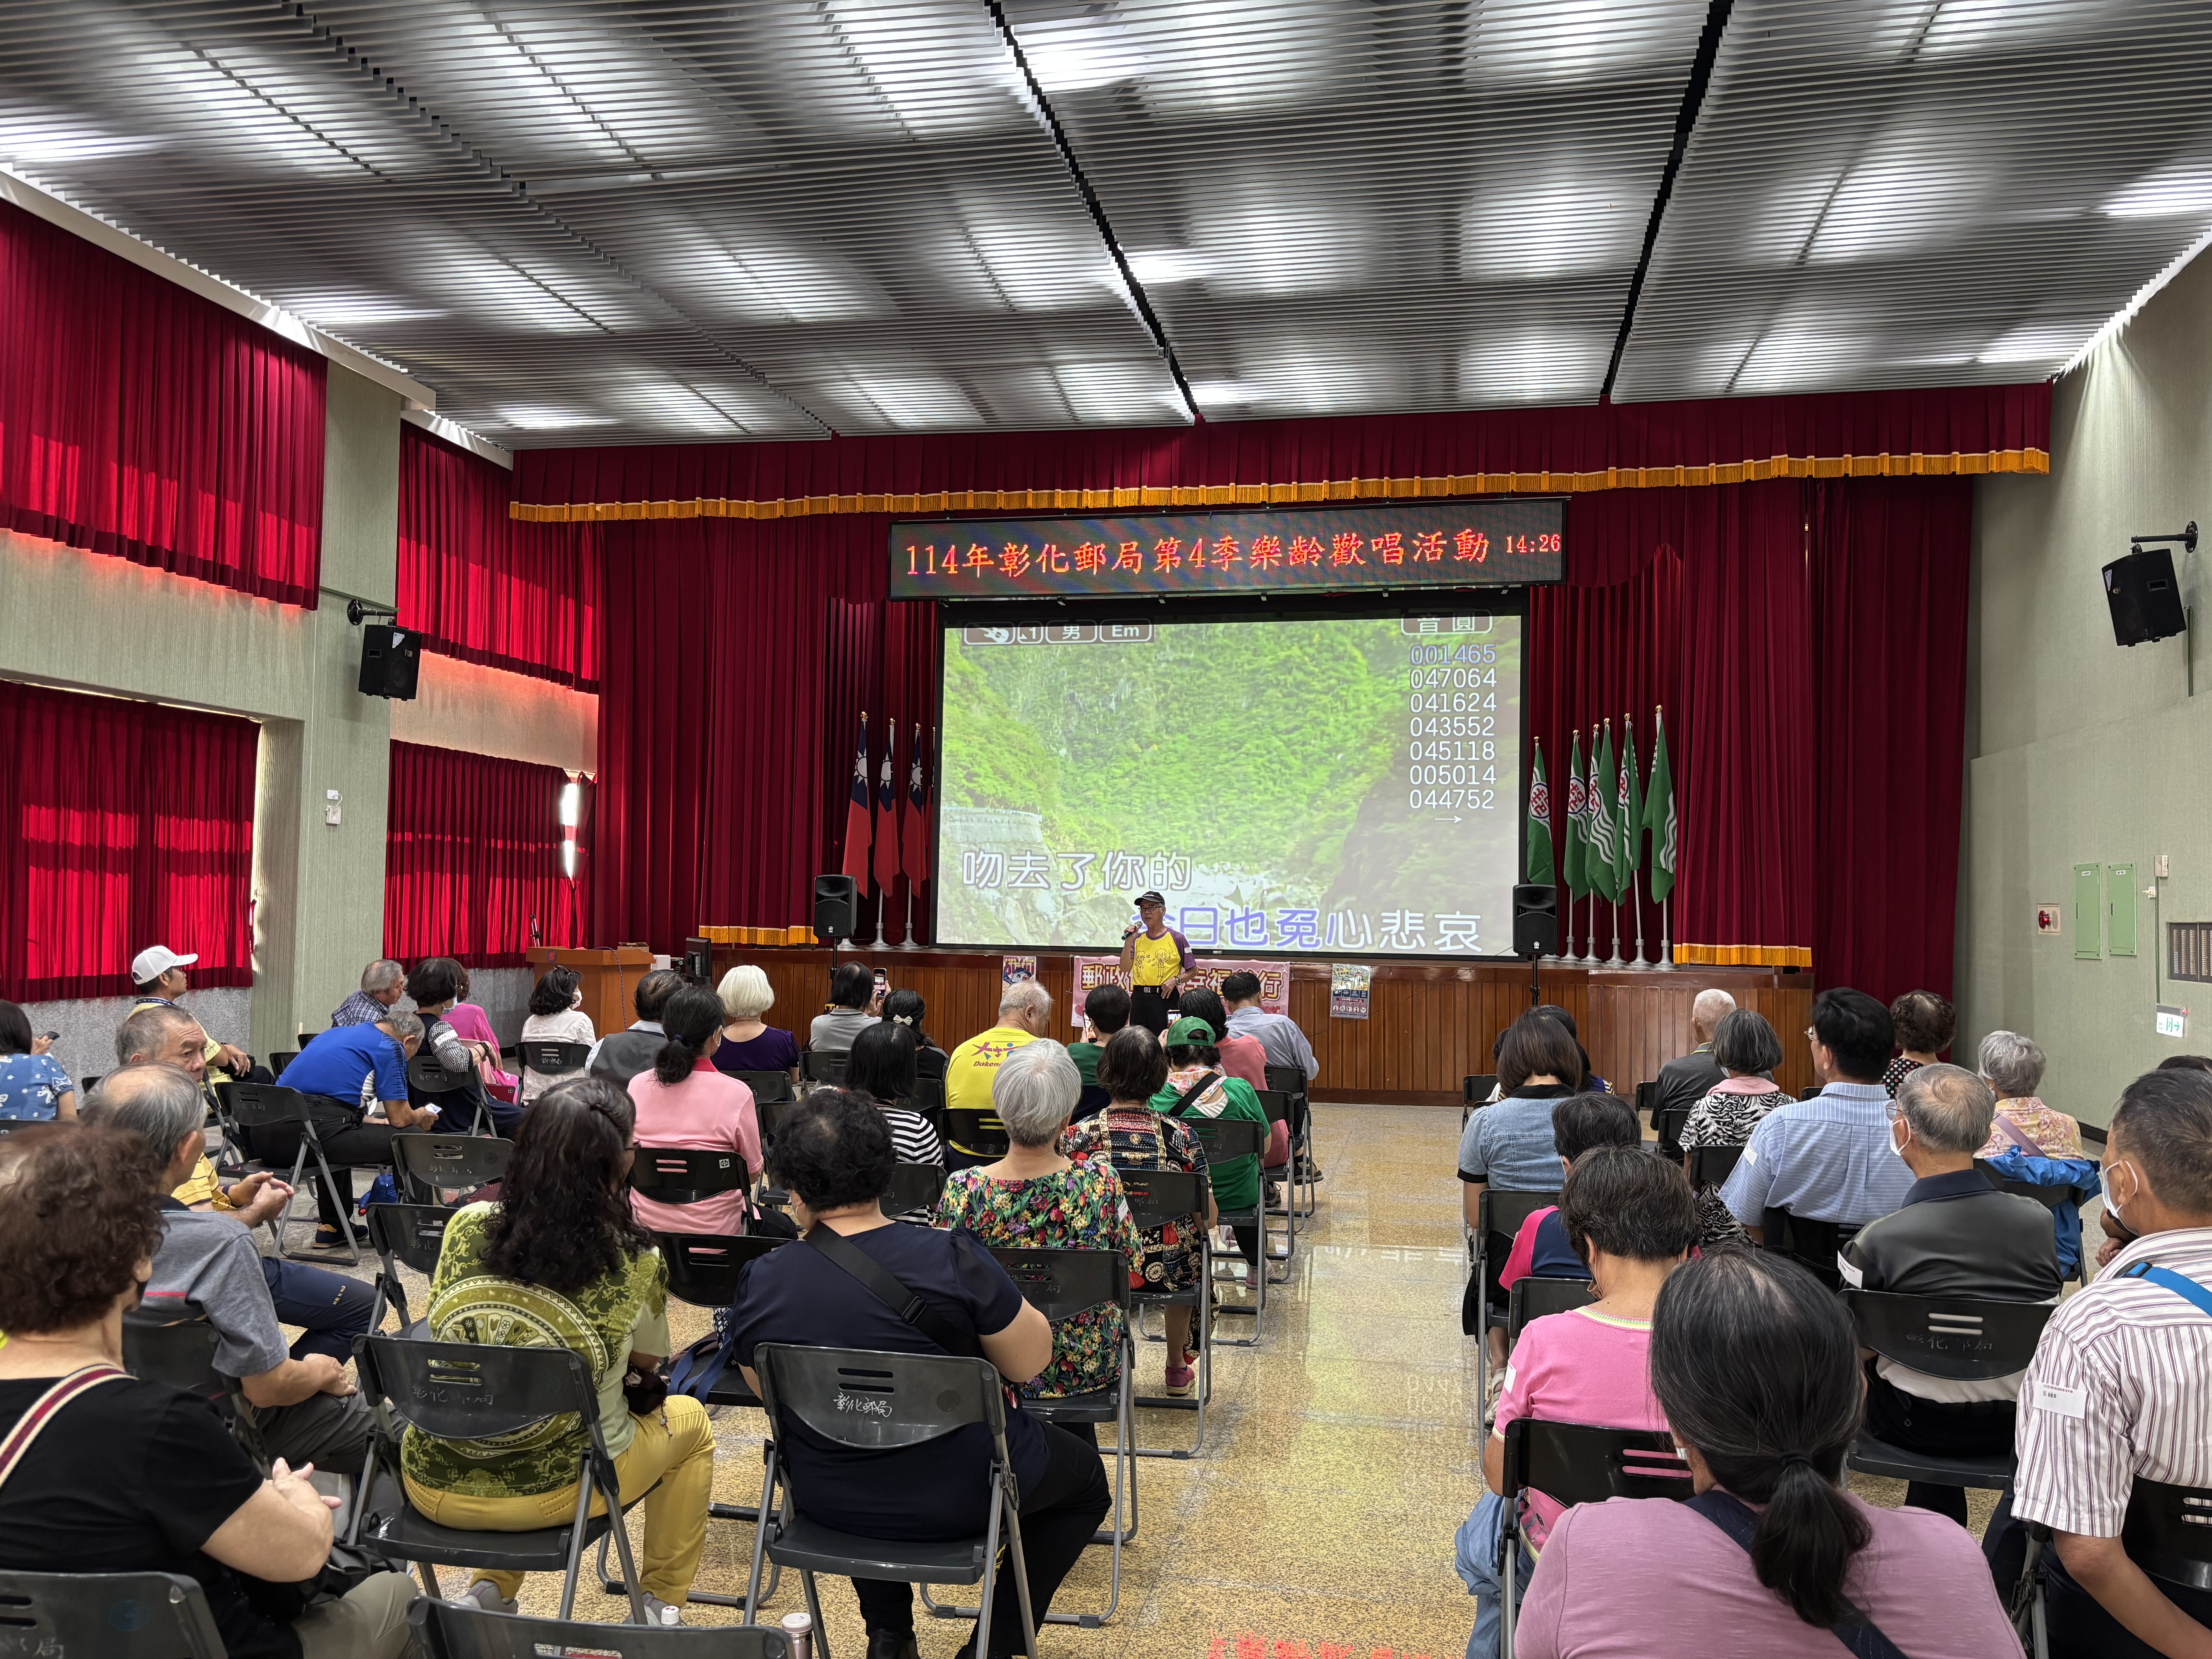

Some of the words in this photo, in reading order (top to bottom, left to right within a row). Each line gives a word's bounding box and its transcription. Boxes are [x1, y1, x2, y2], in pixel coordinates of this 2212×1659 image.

[907, 529, 1489, 577] 114年彰化郵局第4季樂齡歡唱活動
[1506, 534, 1561, 554] 14:26
[1111, 625, 1139, 637] Em
[1411, 644, 1496, 665] 001465
[1411, 668, 1497, 689] 047064
[1410, 692, 1497, 713] 041624
[1410, 716, 1494, 737] 043552
[1410, 741, 1495, 761] 045118
[1410, 765, 1496, 785] 005014
[1410, 789, 1494, 809] 044752
[962, 851, 1192, 890] 吻去了你的
[1131, 907, 1482, 952] 日也免心悲哀
[833, 1392, 892, 1417] 彰化郵局
